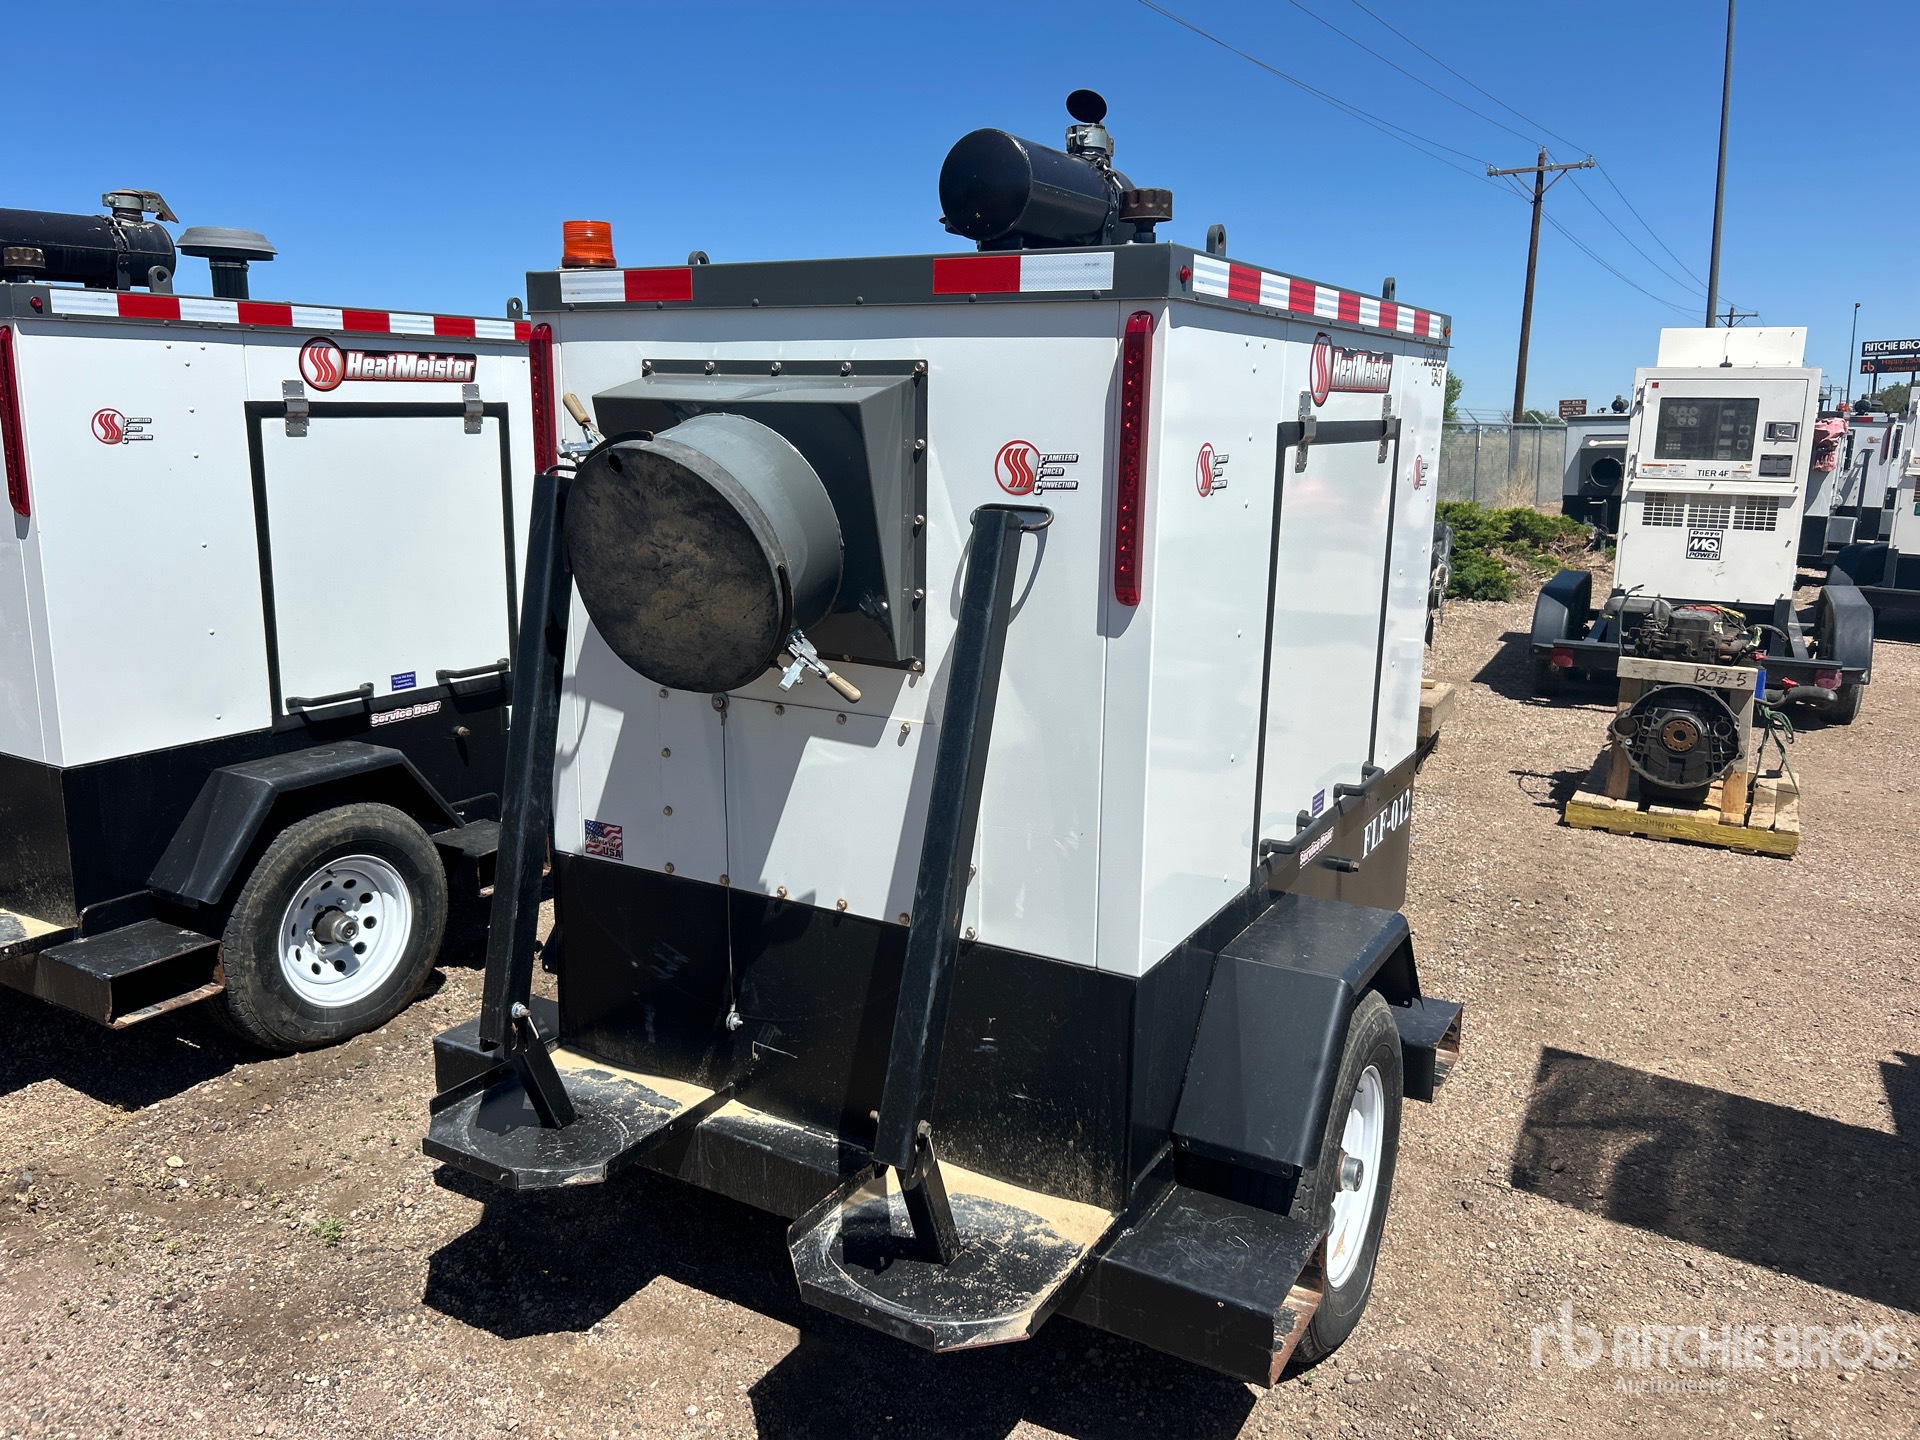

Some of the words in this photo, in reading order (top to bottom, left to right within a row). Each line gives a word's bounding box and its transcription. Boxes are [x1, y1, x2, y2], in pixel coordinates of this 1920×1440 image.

[1865, 342, 1898, 351] RITCHIE
[346, 352, 475, 380] HeatMeister
[1331, 350, 1392, 389] HeatMeister
[1038, 454, 1078, 467] FLAMELESS
[1036, 467, 1064, 481] FORCED
[1033, 480, 1078, 495] CONVECTION
[1690, 538, 1719, 551] MQ
[371, 708, 413, 726] Service
[413, 702, 441, 716] Door
[1362, 788, 1410, 860] FLF-012
[603, 847, 621, 858] USA
